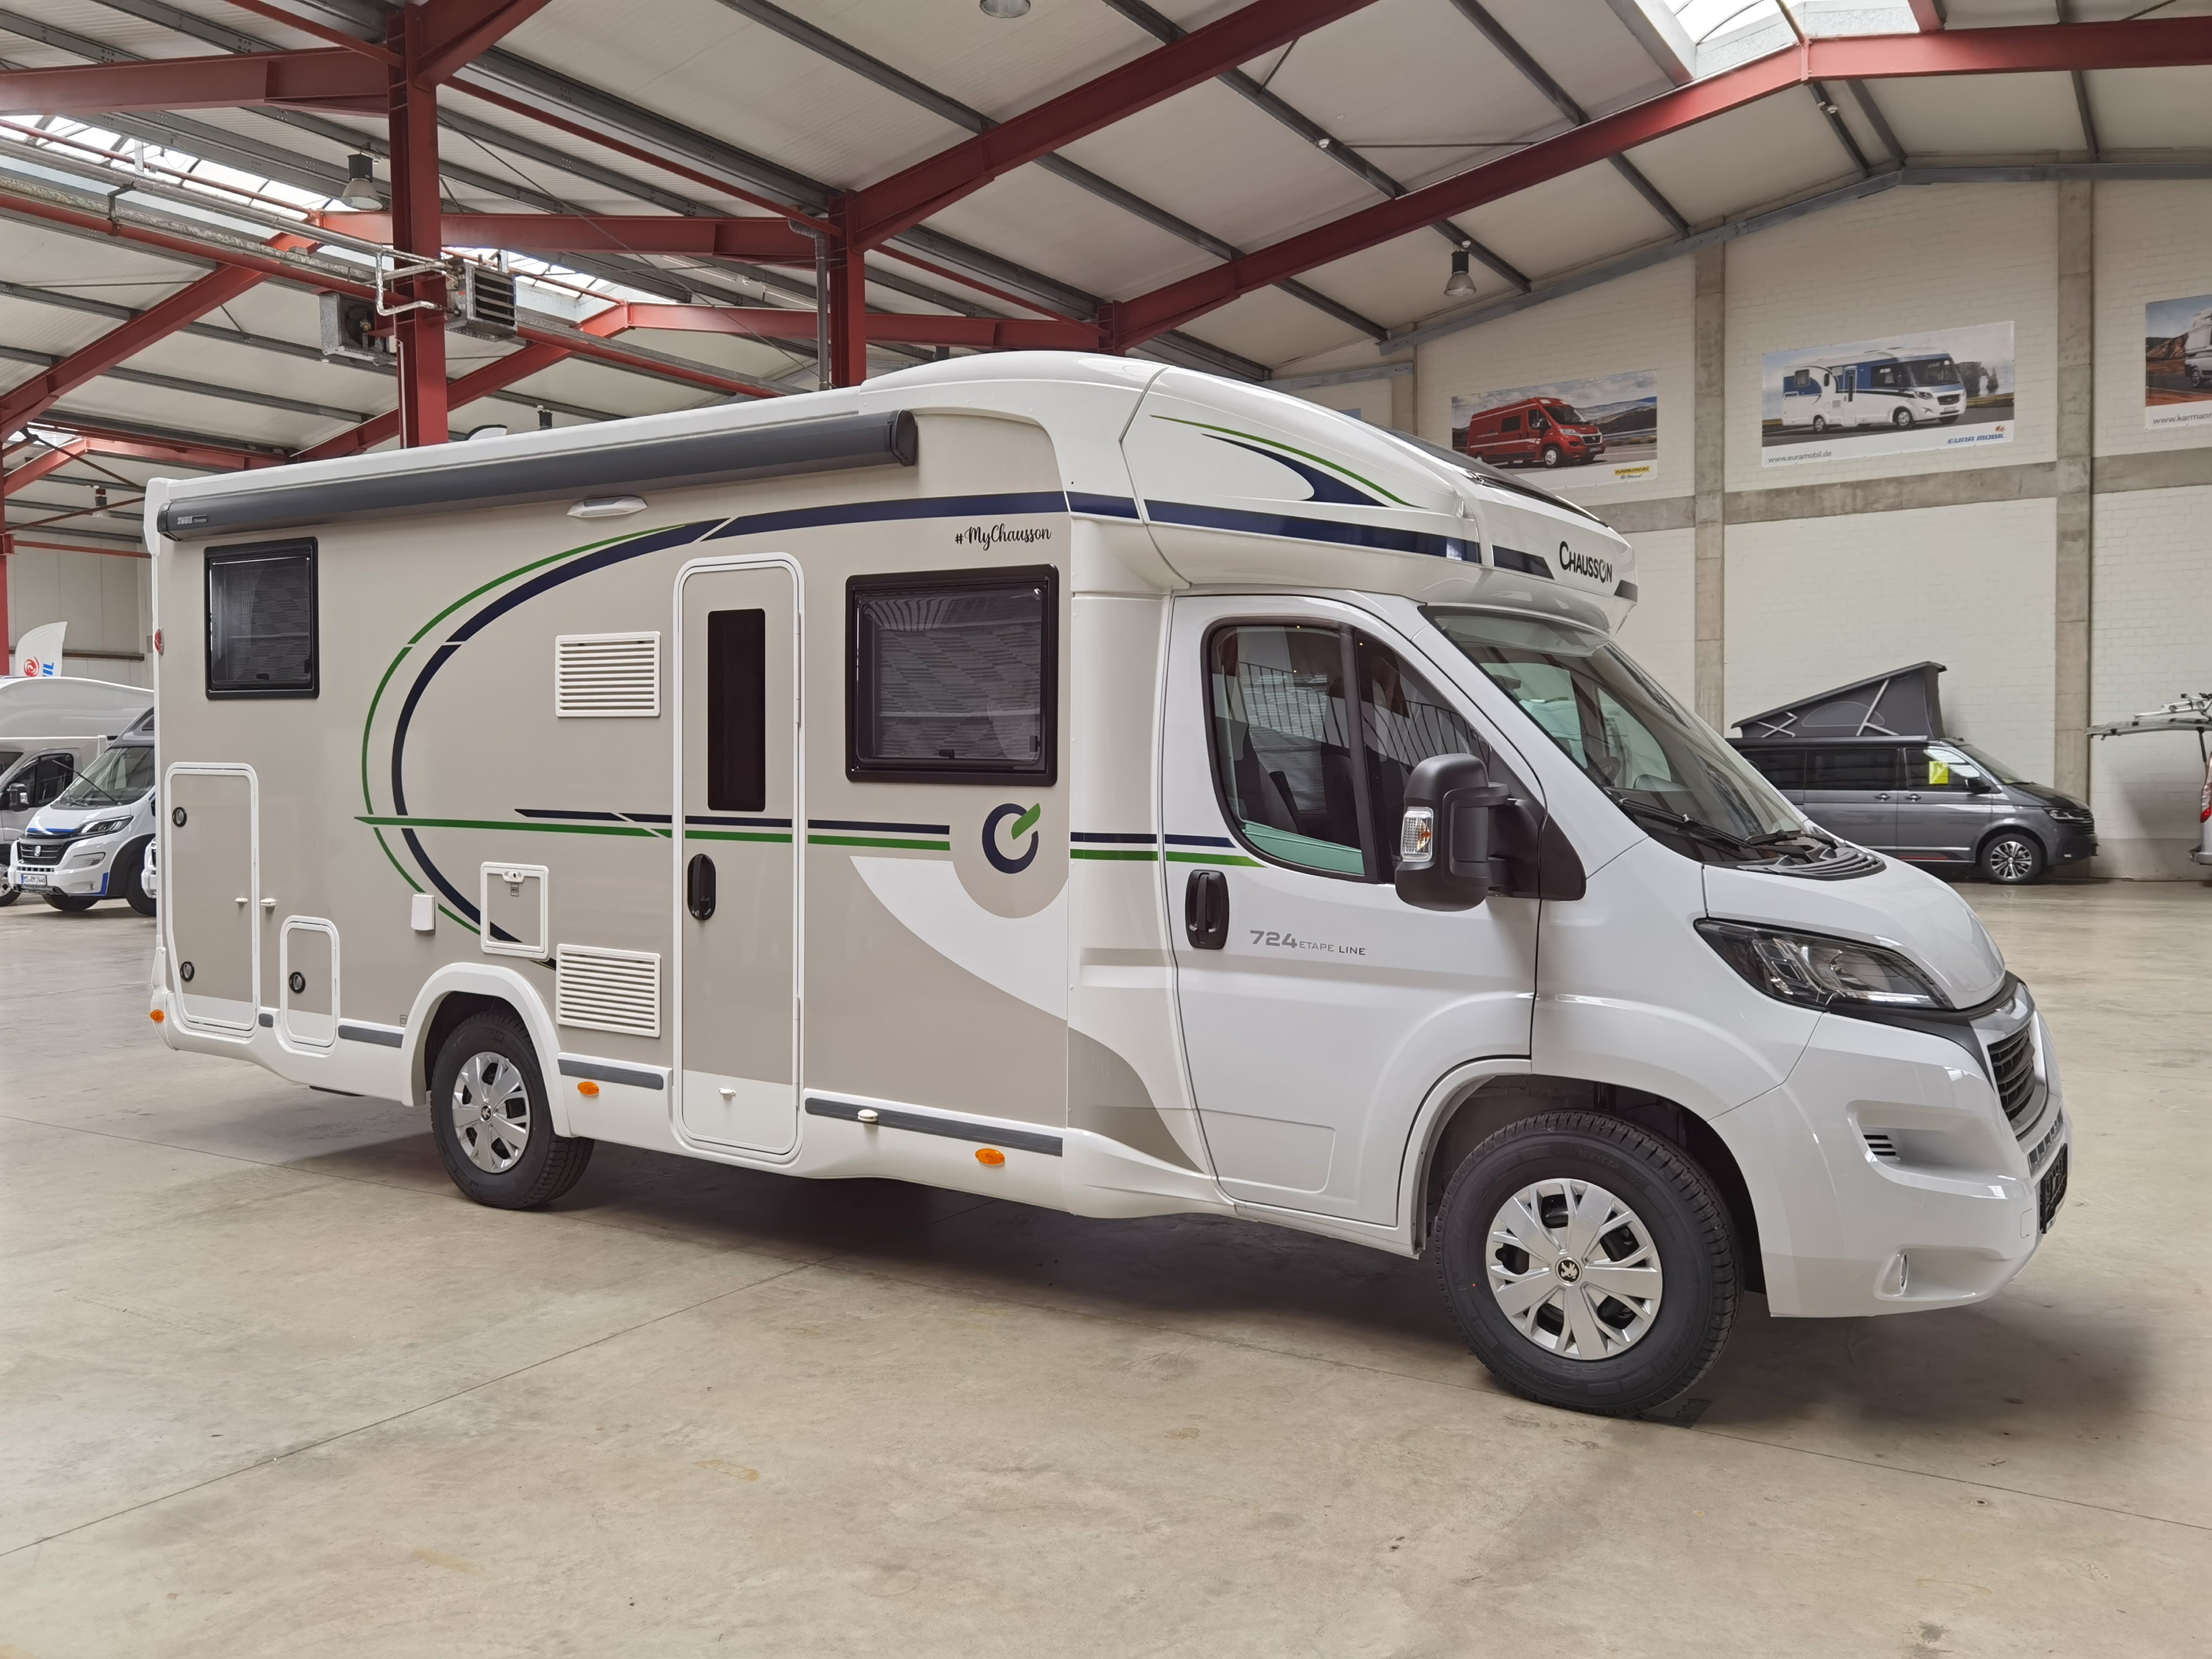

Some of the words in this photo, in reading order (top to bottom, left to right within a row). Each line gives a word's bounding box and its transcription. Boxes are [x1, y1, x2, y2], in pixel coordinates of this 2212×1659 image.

[1977, 433, 2005, 441] MOBIL
[1768, 450, 1832, 462] www.euramobil.de
[177, 516, 193, 525] THULE
[955, 523, 1051, 551] #MyChausson
[1250, 930, 1297, 948] 724
[1299, 941, 1334, 952] ETAPE
[1339, 946, 1366, 955] LINE
